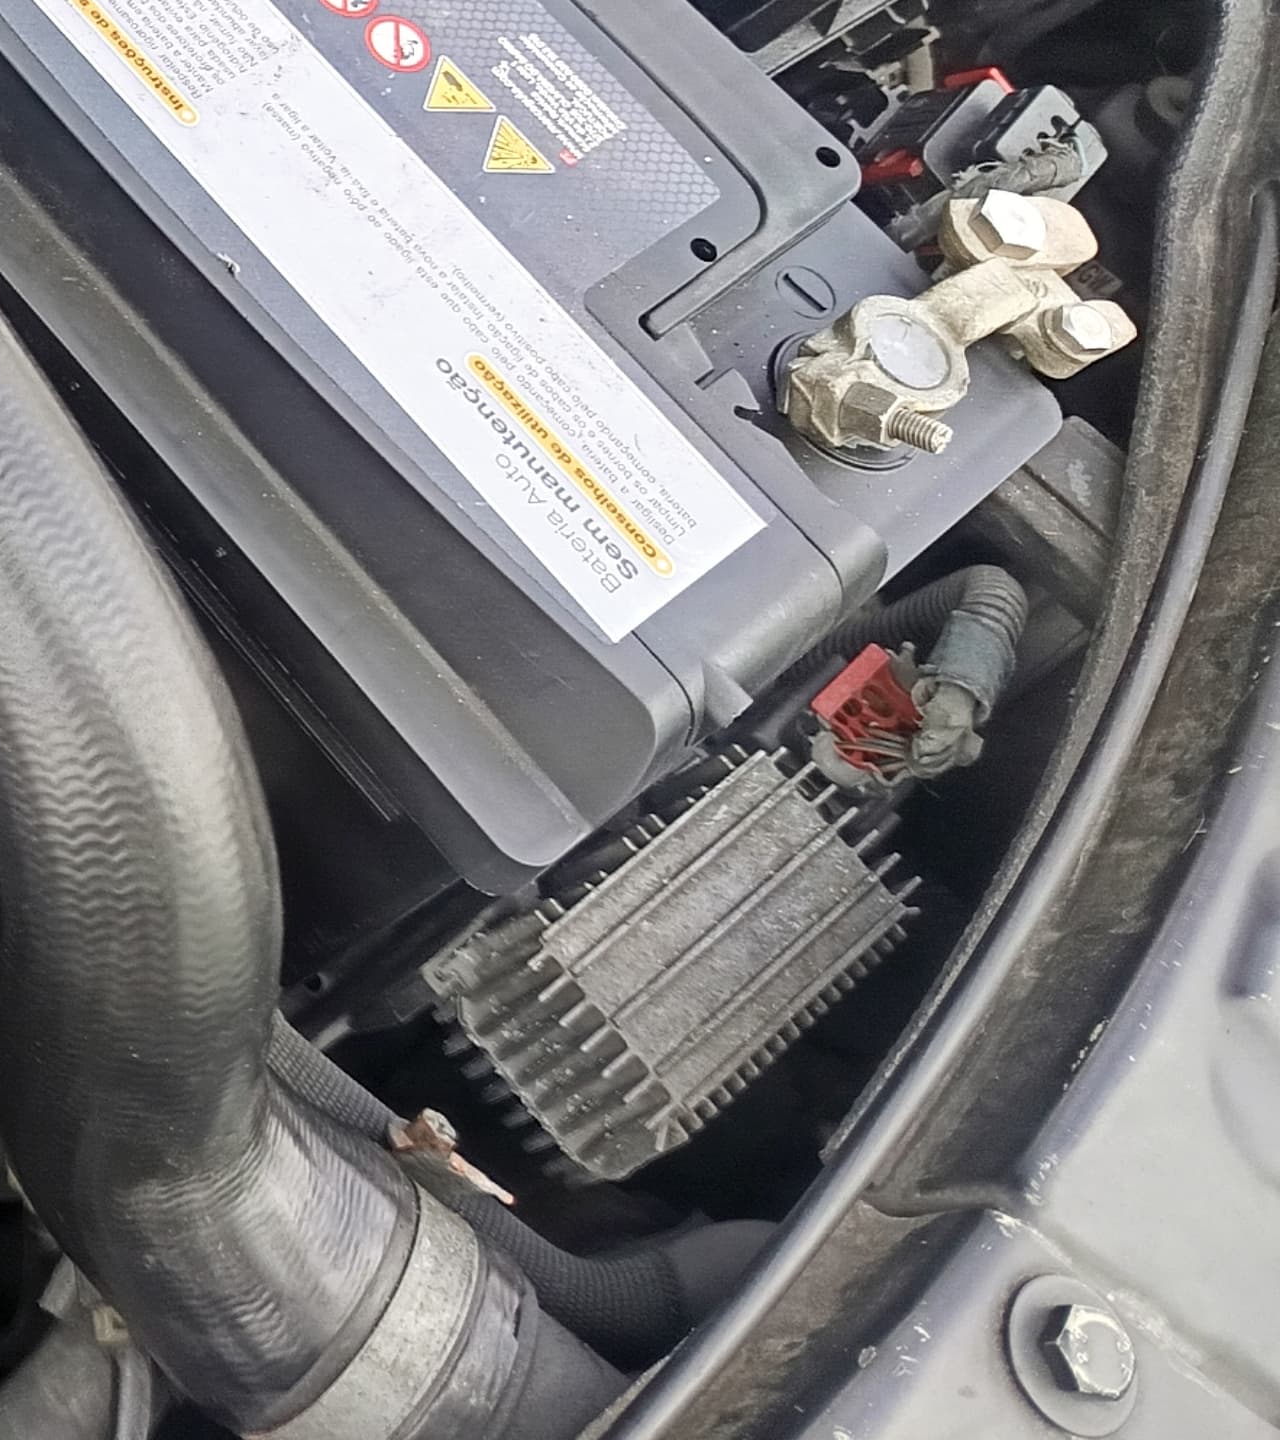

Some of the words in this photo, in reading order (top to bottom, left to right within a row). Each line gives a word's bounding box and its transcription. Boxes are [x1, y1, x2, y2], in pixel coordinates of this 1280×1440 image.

[86, 8, 111, 30] de
[105, 29, 186, 111] Instruções
[428, 352, 585, 516] manutenção
[469, 356, 552, 441] utilização
[488, 449, 549, 511] Auto
[546, 440, 573, 466] de
[540, 507, 624, 595] Bateria
[569, 465, 660, 559] Conselhos
[576, 516, 641, 582] Sem
